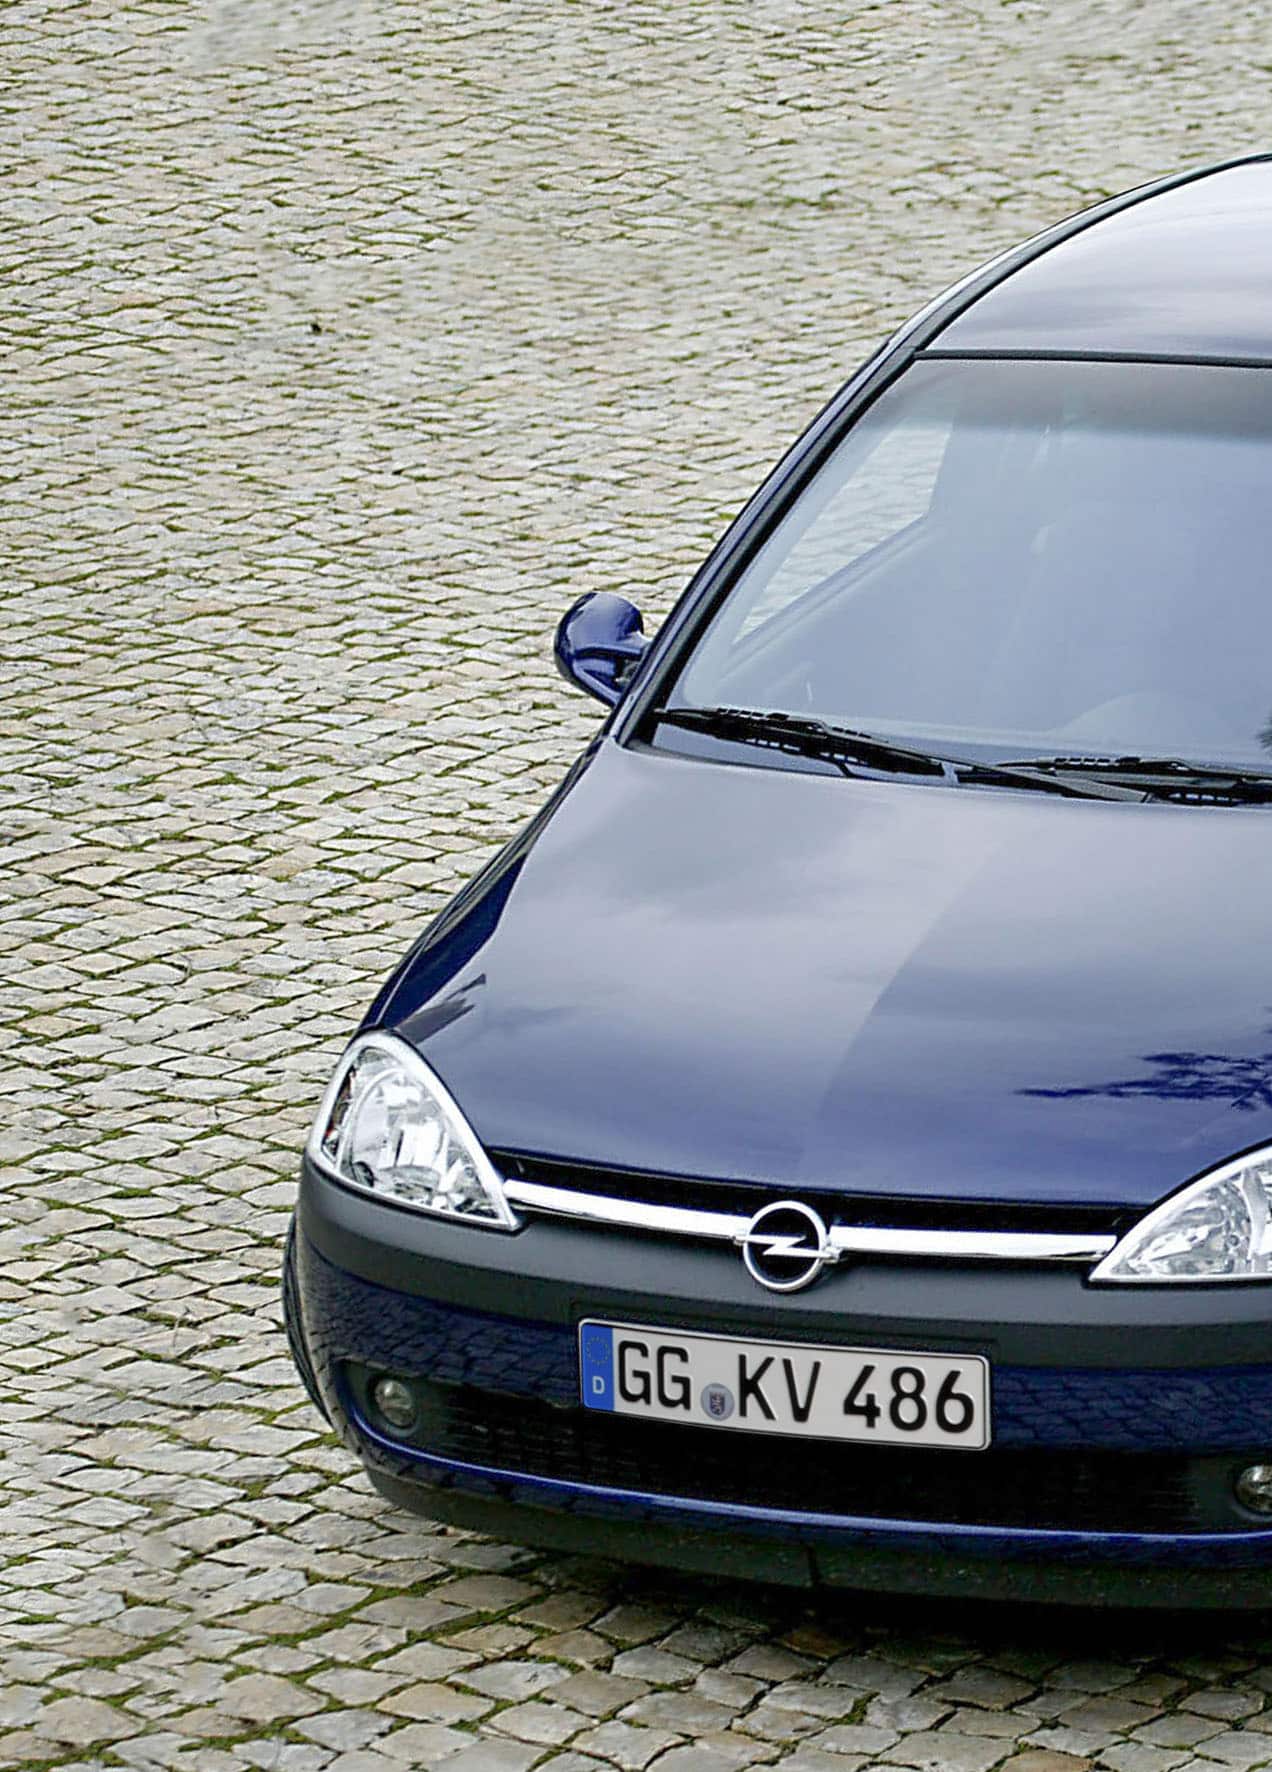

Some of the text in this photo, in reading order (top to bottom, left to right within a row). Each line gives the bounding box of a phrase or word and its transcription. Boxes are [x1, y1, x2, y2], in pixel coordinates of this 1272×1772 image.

[592, 1377, 605, 1395] D
[618, 1340, 975, 1433] GG KV 486
